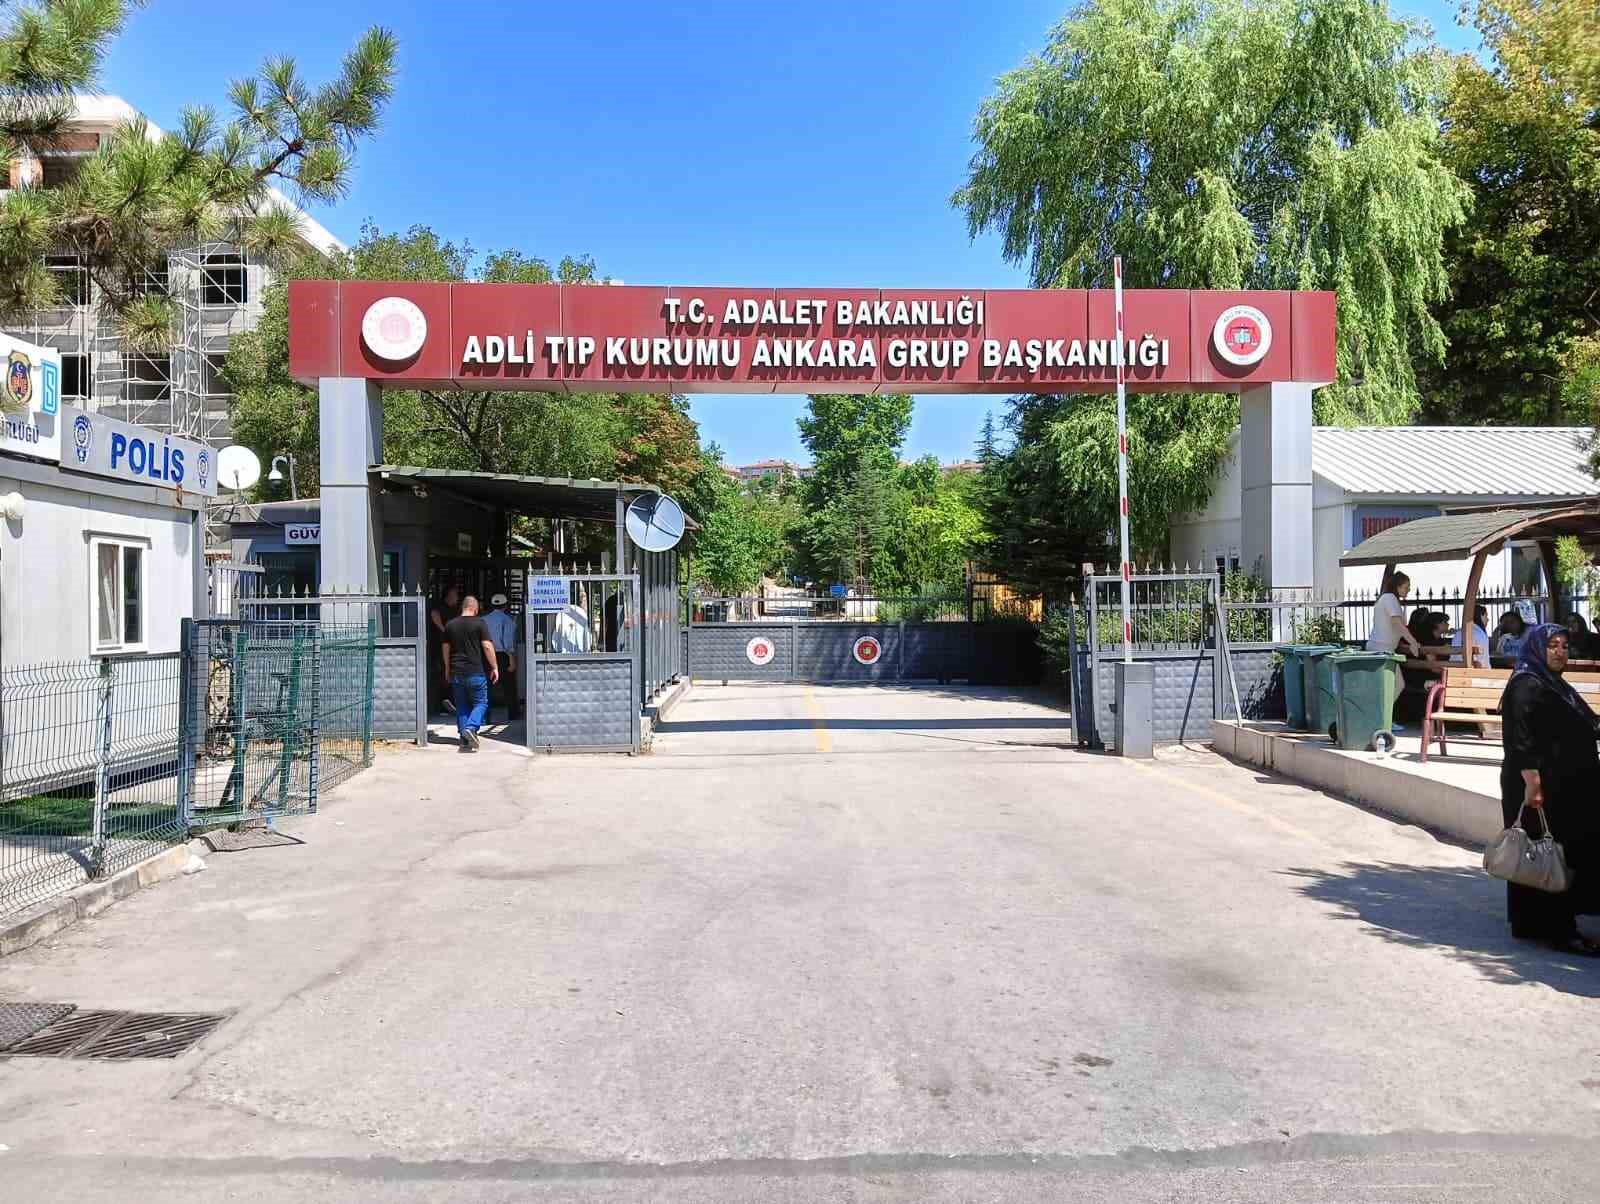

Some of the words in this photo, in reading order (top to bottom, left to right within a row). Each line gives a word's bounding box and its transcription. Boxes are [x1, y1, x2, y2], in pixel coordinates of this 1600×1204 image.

[664, 298, 713, 324] T.C.
[723, 299, 827, 325] ADALET
[837, 296, 984, 326] BAKANLIĞI
[462, 330, 534, 363] ADLİ
[545, 336, 596, 365] TIP
[606, 337, 741, 367] KURUMU
[752, 339, 878, 367] ANKARA
[887, 339, 969, 368] GRUP
[983, 333, 1169, 374] BAŞKANLIĞI
[111, 432, 185, 483] POLİS
